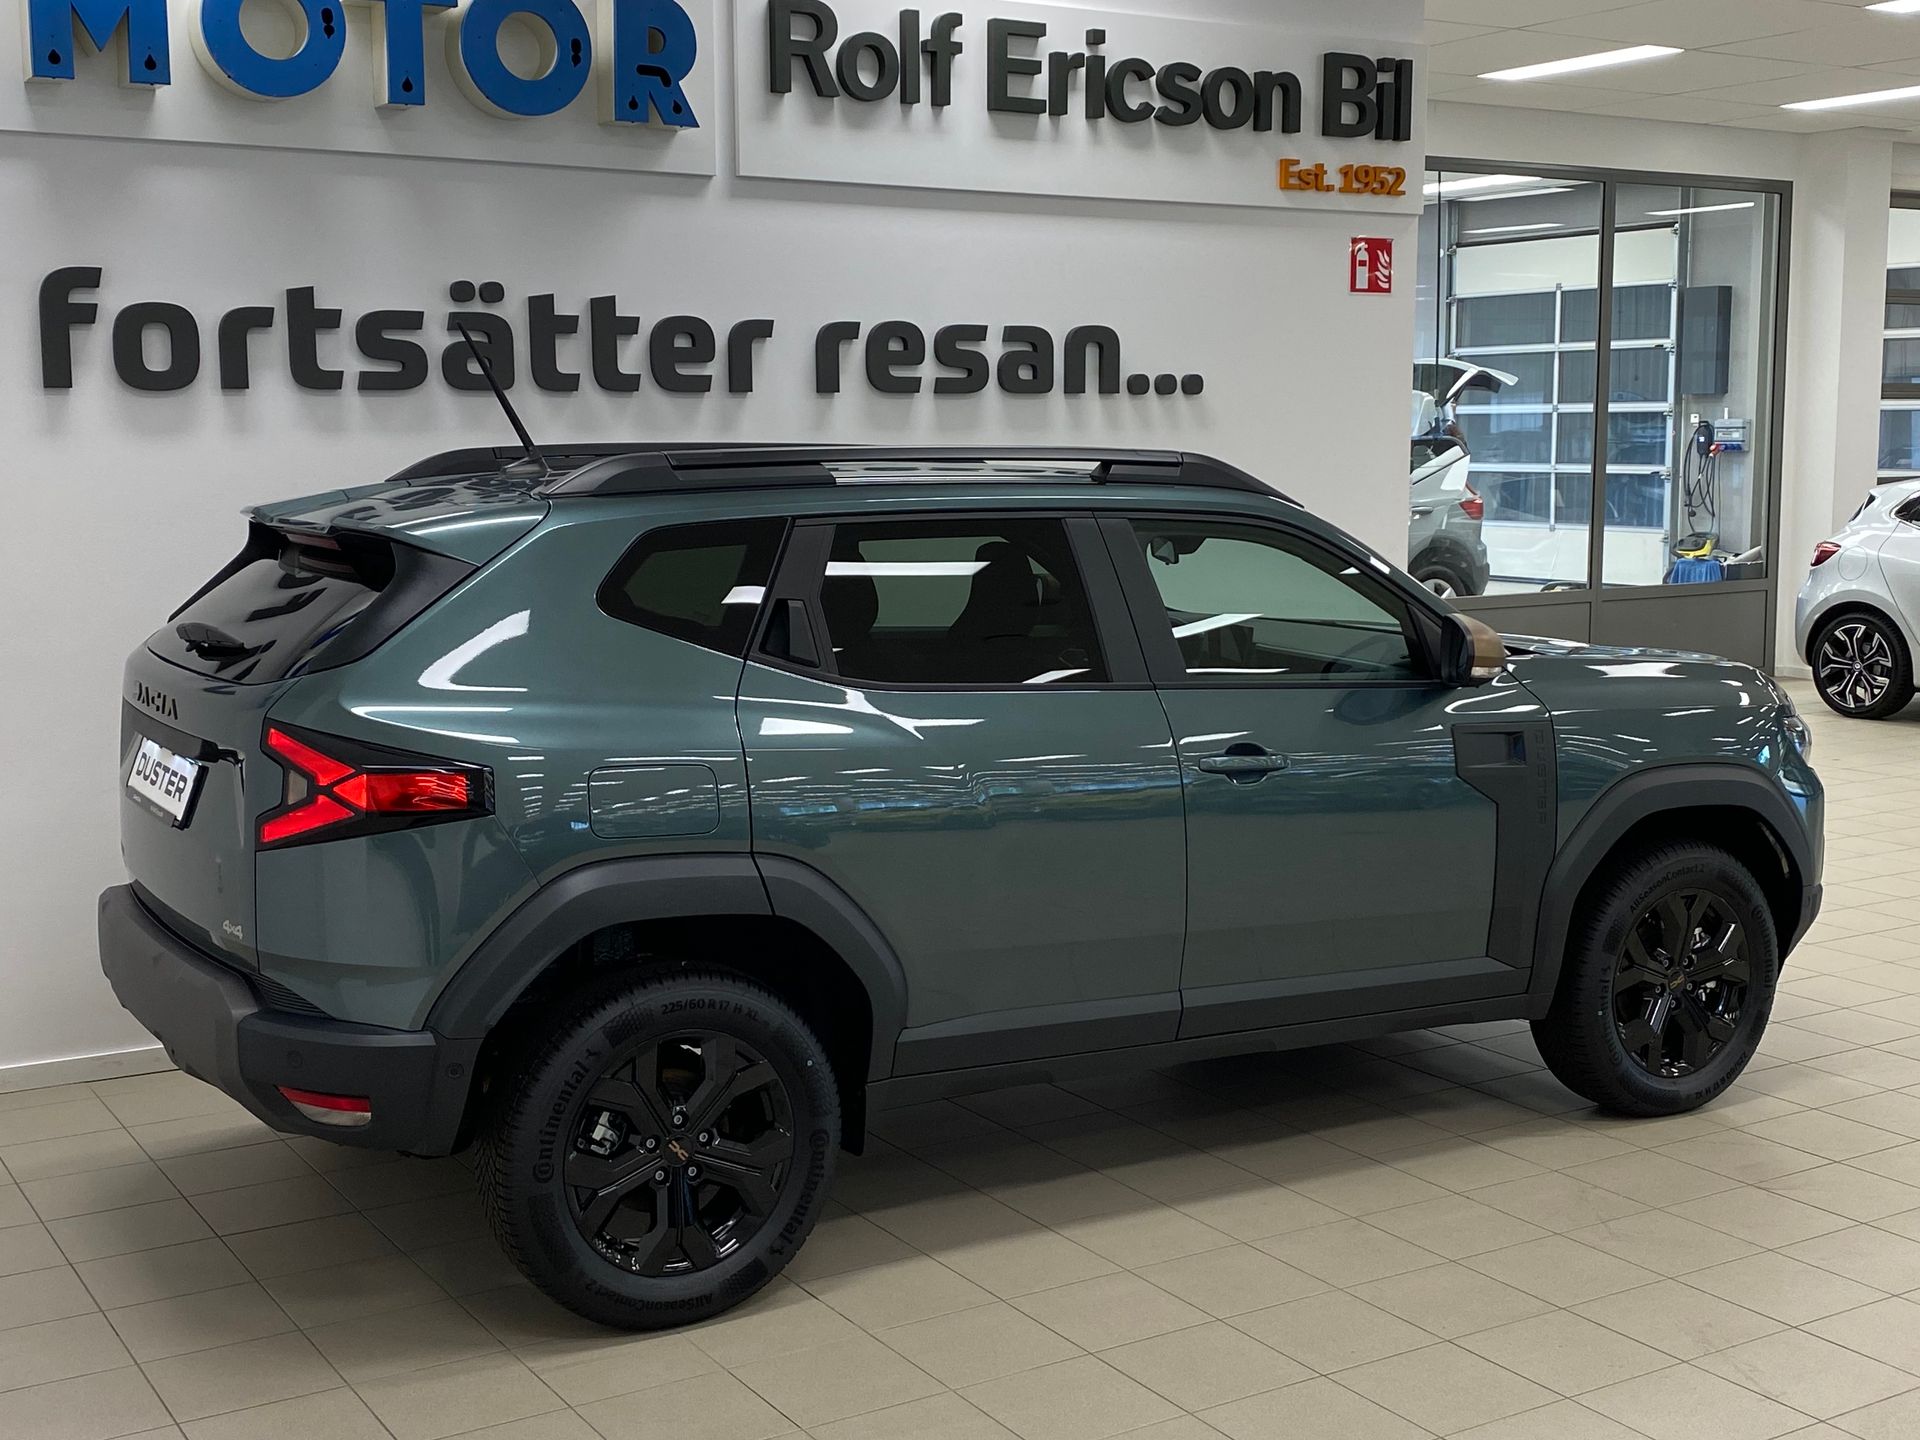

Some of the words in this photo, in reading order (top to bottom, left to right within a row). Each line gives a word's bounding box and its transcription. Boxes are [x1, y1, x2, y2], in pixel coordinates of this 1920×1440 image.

[24, 0, 700, 130] MOTOR
[769, 0, 963, 107] Rolf
[987, 17, 1301, 134] Ericson
[1322, 52, 1413, 141] Bil
[1280, 158, 1335, 192] Est.
[1338, 164, 1406, 196] 1952
[38, 266, 774, 394] fortsätter
[815, 319, 1204, 397] resan...
[135, 752, 188, 802] DUSTER
[660, 998, 706, 1015] 225/60
[707, 998, 717, 1010] R
[719, 999, 731, 1011] 17
[532, 1059, 591, 1183] Continental
